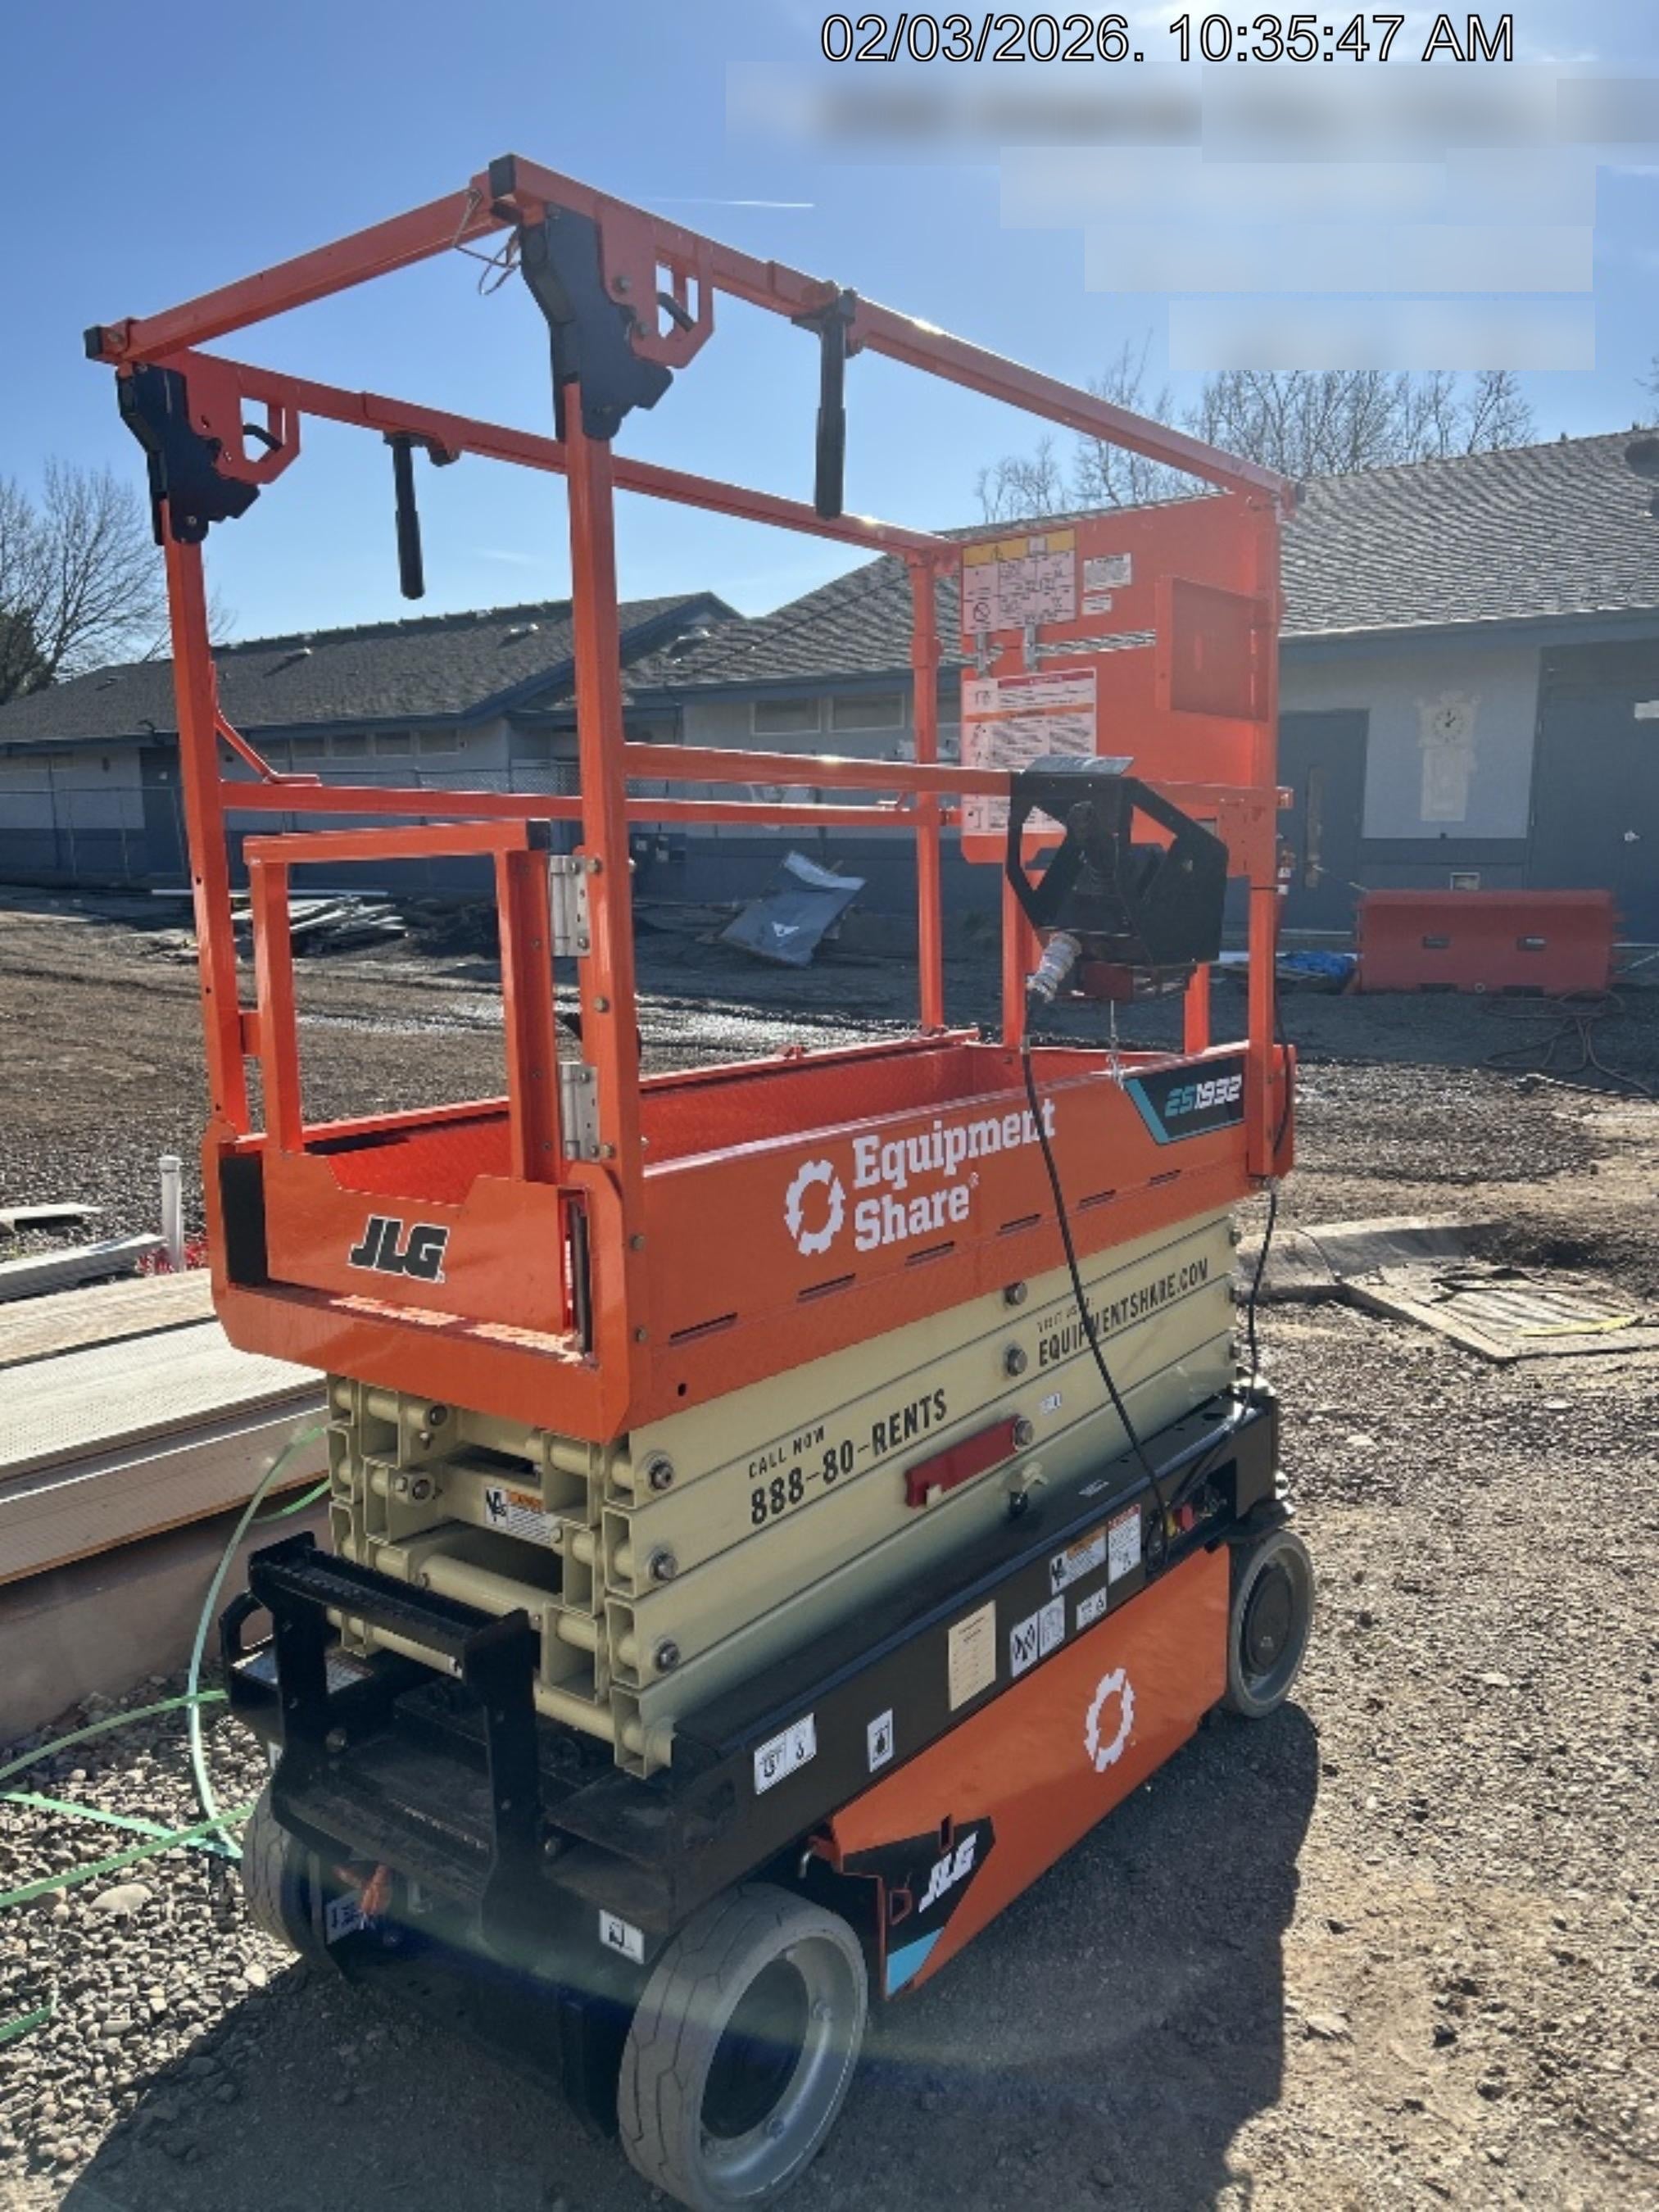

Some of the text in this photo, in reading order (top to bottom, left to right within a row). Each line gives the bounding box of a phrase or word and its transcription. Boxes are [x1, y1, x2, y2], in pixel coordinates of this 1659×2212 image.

[1164, 1073, 1243, 1117] ES1932
[852, 1098, 1055, 1190] Equipment
[347, 1213, 450, 1283] JLG
[749, 1426, 824, 1479] CALL NOW
[751, 1388, 947, 1525] 888-80-RENTS
[918, 1830, 978, 1913] JLG
